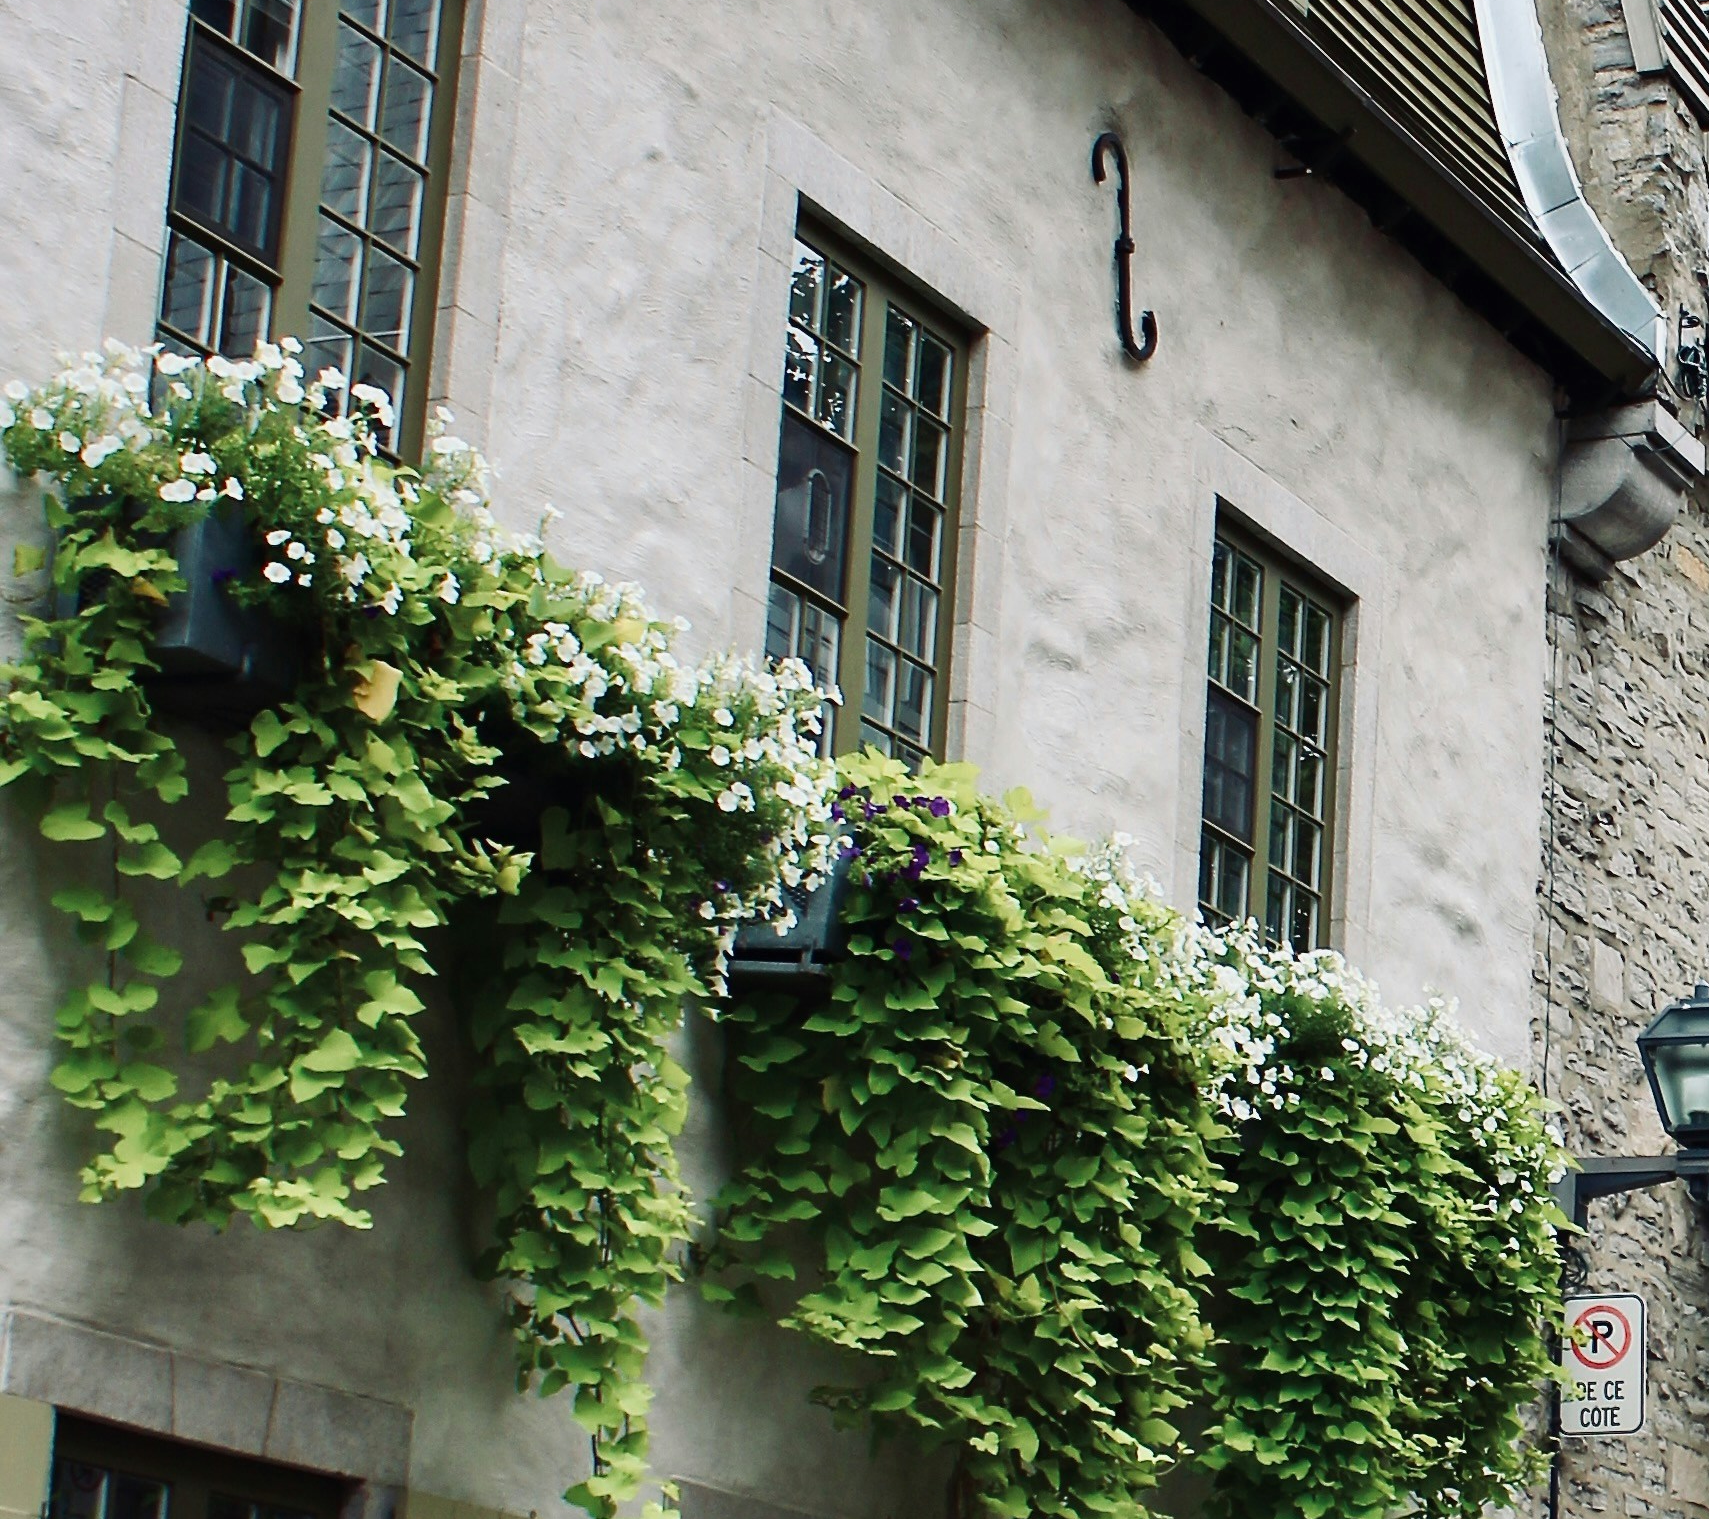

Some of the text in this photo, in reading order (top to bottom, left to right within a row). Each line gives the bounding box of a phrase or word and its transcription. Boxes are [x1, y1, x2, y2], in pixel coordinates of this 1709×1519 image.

[1592, 1320, 1613, 1353] P
[1577, 1380, 1625, 1401] DE CE
